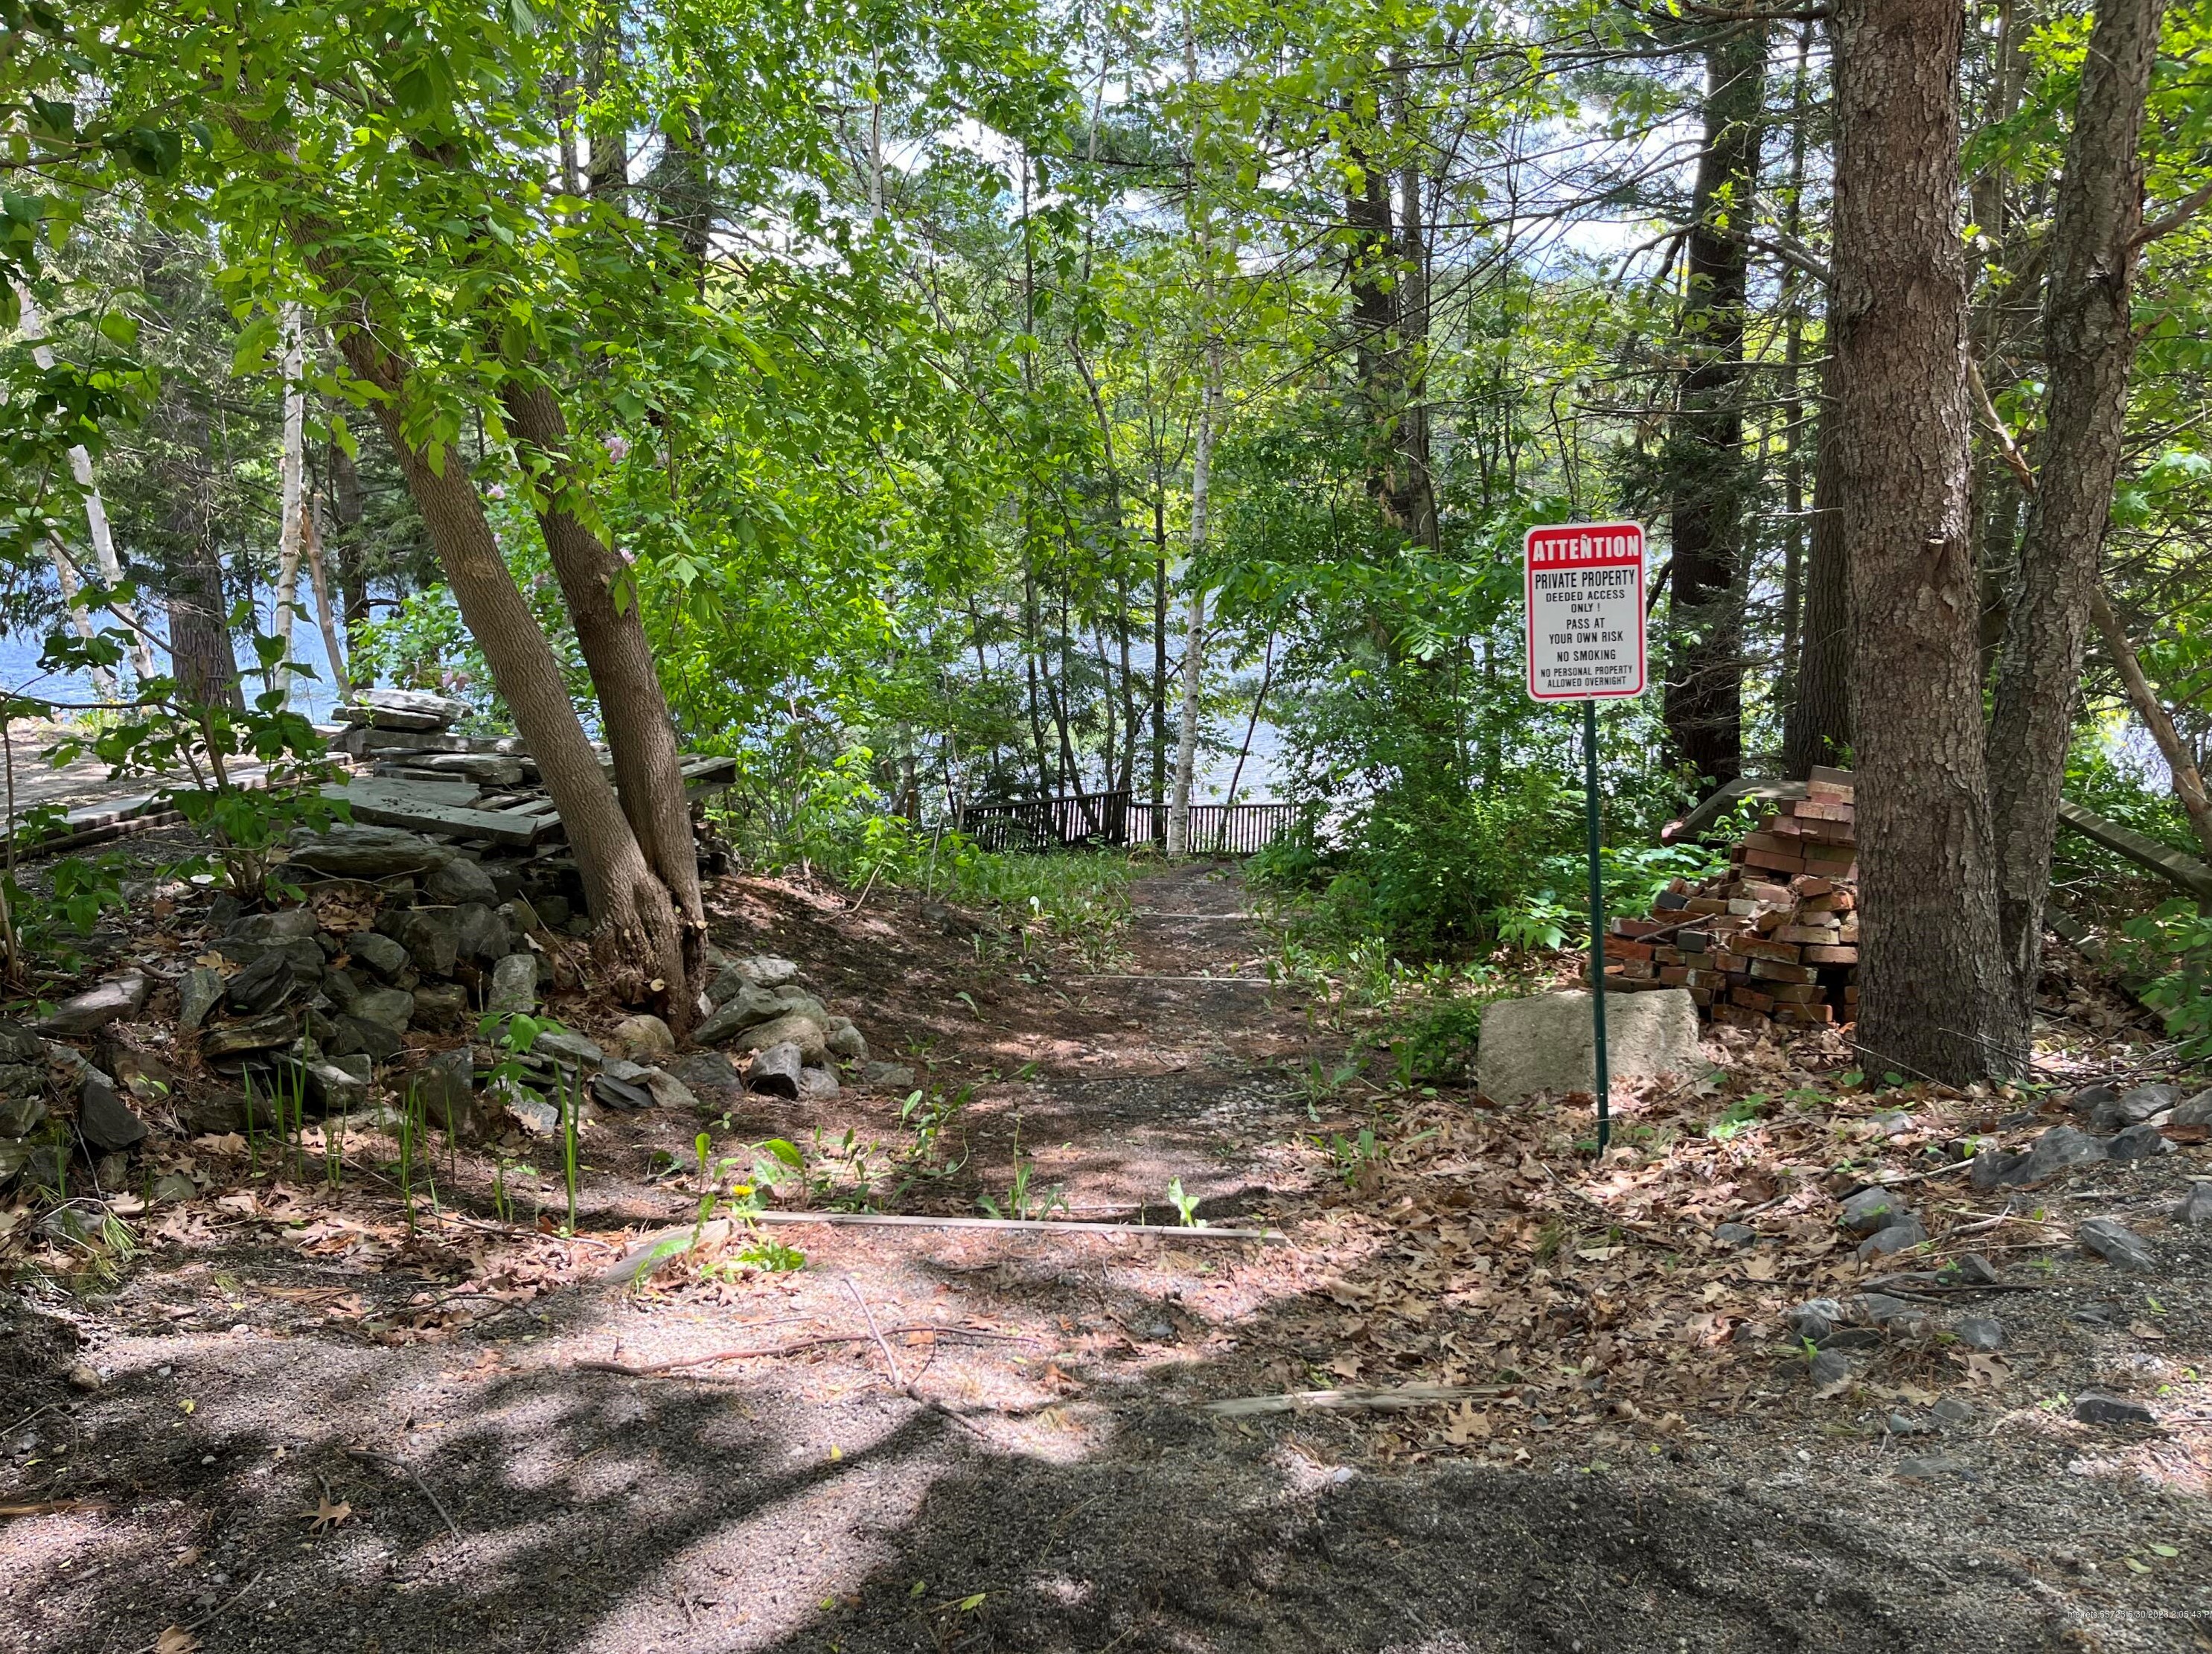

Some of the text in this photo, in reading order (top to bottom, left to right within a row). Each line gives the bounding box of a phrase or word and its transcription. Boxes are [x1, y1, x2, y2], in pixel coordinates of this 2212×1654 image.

[1532, 534, 1639, 562] ATTENTION
[1535, 569, 1635, 590] PRIVATE PROPERTY
[1546, 590, 1625, 602] DEEDED ACCESS
[1571, 603, 1593, 613] ONLY
[1566, 618, 1605, 630] PASS AT
[1549, 630, 1624, 645] YOUR OWN RISK
[1557, 649, 1616, 662] NO SMOKING
[1541, 665, 1633, 677] NO PERSONAL PROPERTY
[1547, 676, 1626, 688] ALLOWED OVERNIGHT
